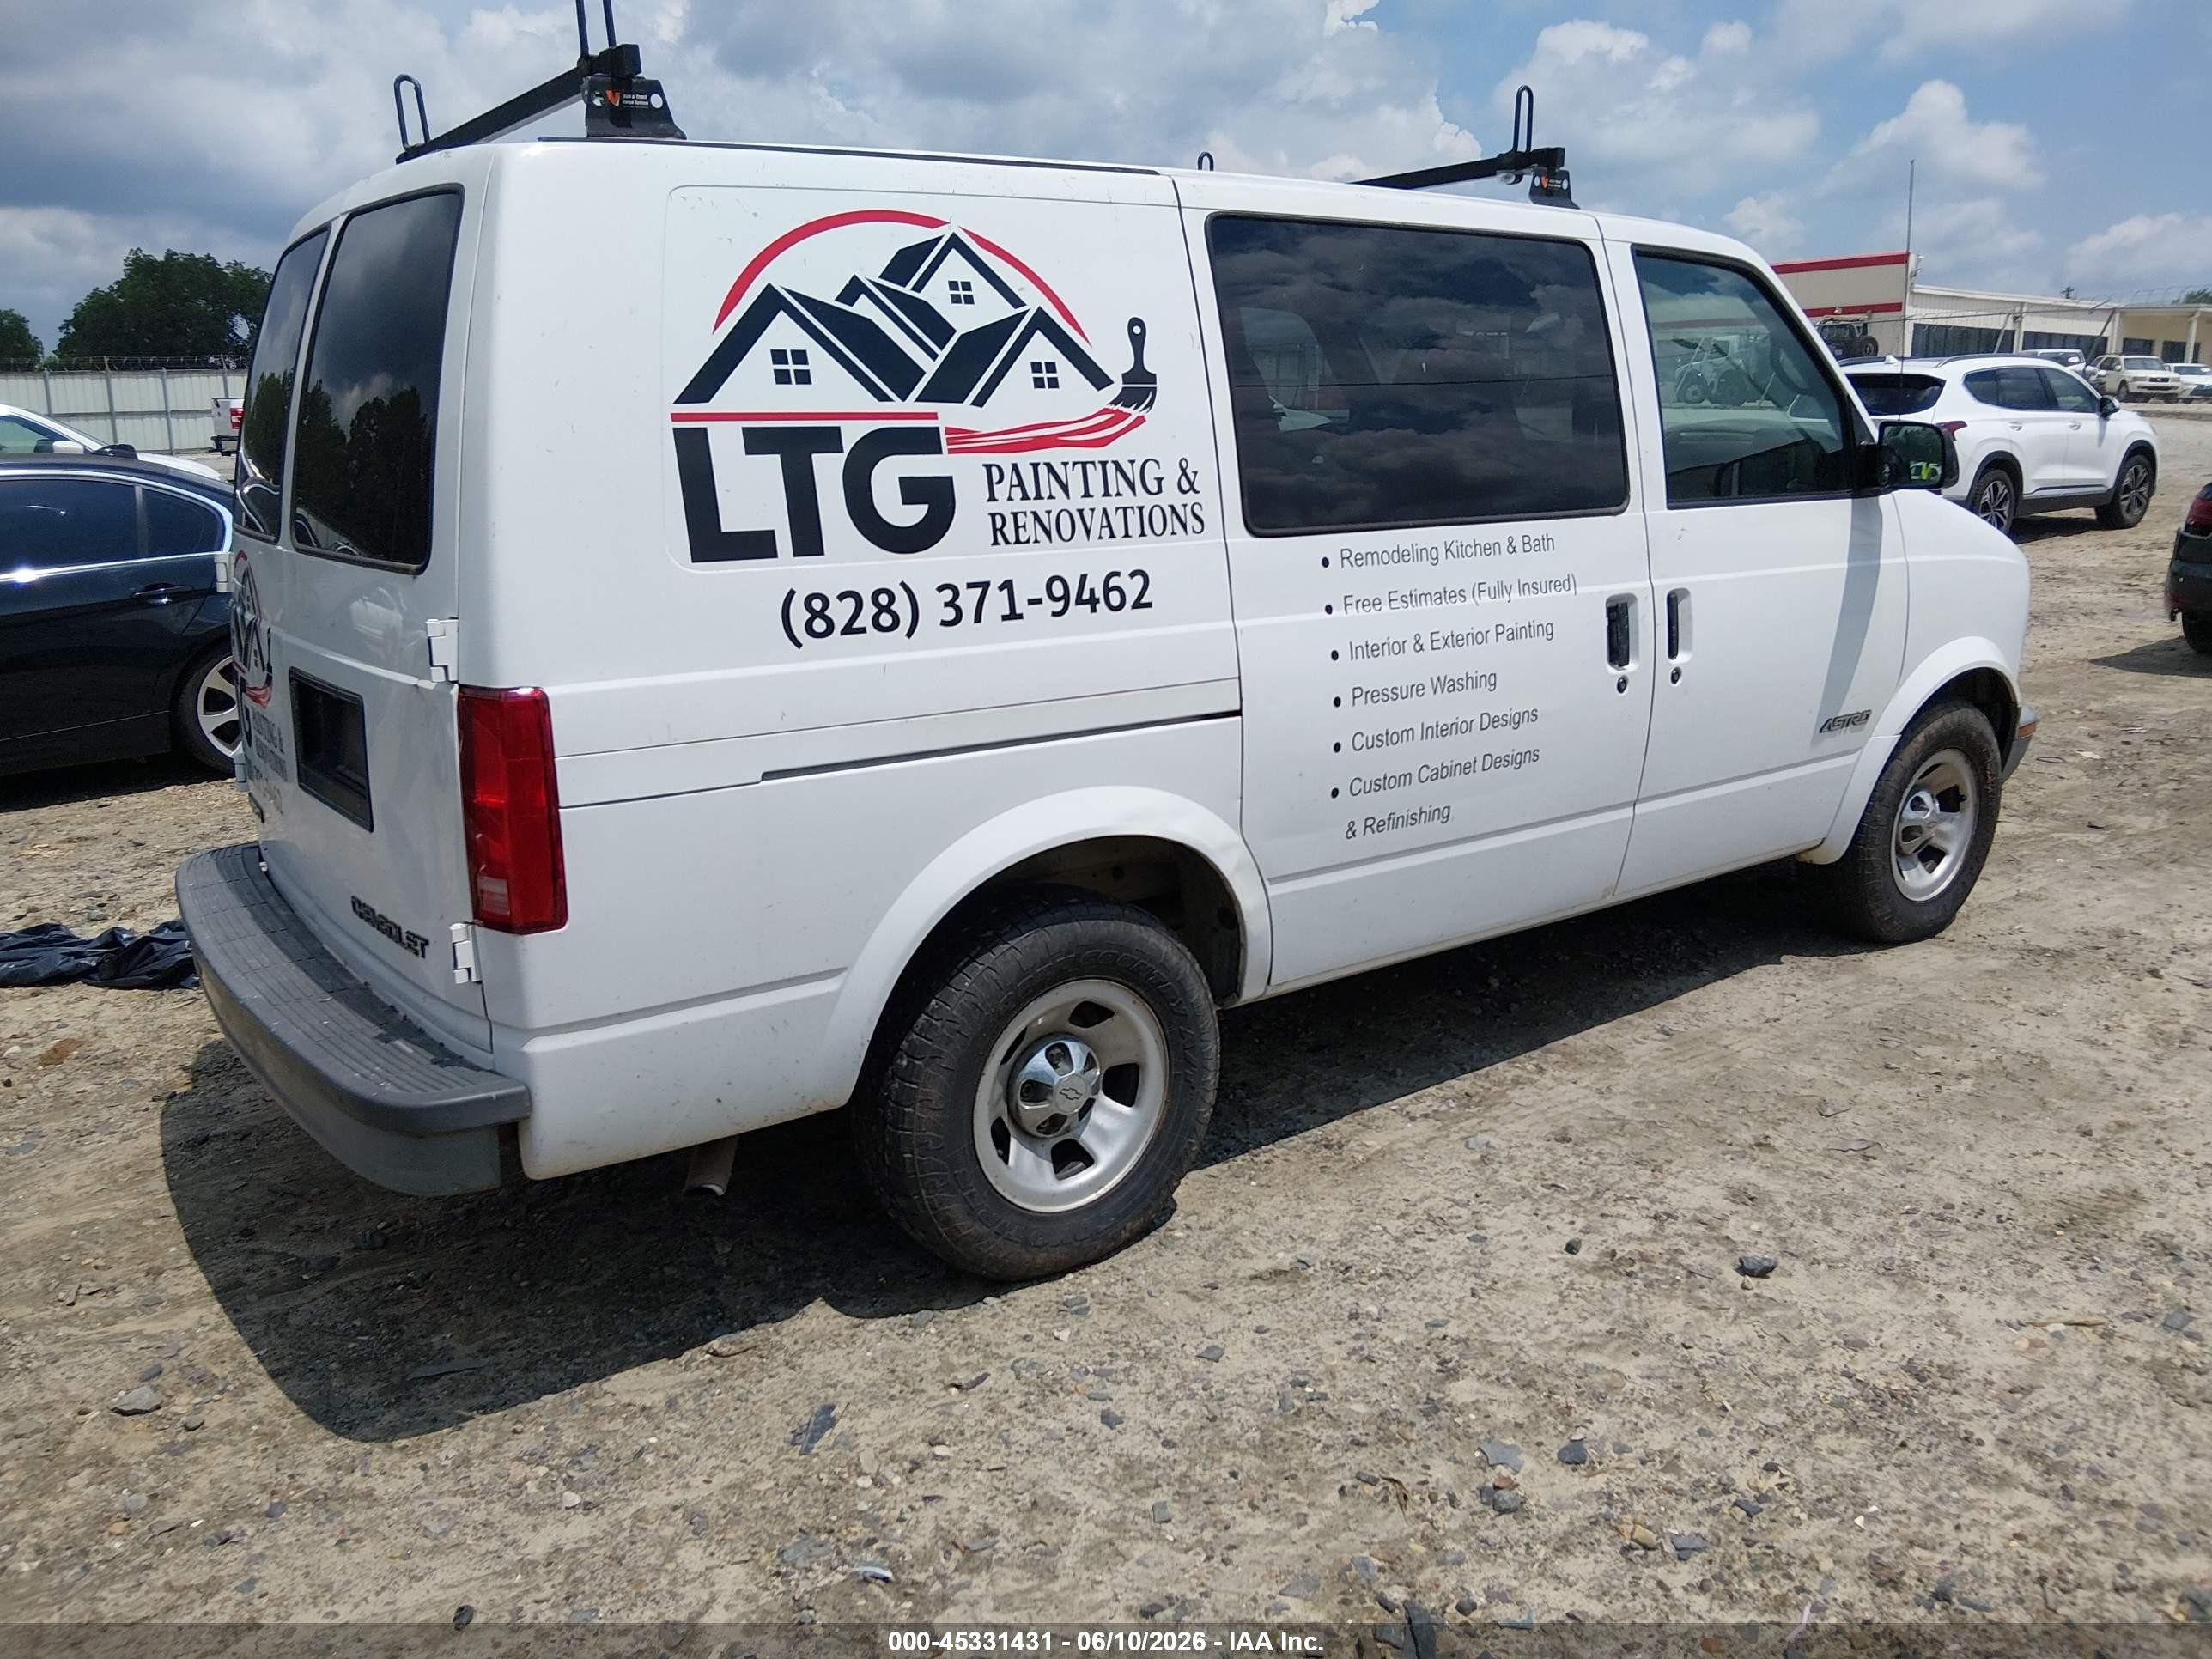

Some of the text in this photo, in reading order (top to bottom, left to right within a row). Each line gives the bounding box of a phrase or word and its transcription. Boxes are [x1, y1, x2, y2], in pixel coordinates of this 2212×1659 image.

[672, 426, 957, 563] LTG
[982, 457, 1200, 503] PAINTING &
[988, 501, 1206, 547] RENOVATIONS
[1340, 532, 1555, 568] Remodeling Kitchen & Bath
[781, 568, 1153, 649] (828) 371-9462
[1343, 574, 1577, 615] Free Estimates (Fully Insured)
[1349, 619, 1554, 661] Interior & Exterior Painting
[1352, 670, 1498, 707] Pressure Washing
[1352, 708, 1539, 752] Custom Interior Designs
[1819, 709, 1872, 733] ASTRO
[1349, 747, 1540, 797] Custom Cabinet Designs
[1345, 805, 1451, 840] & Refinishing
